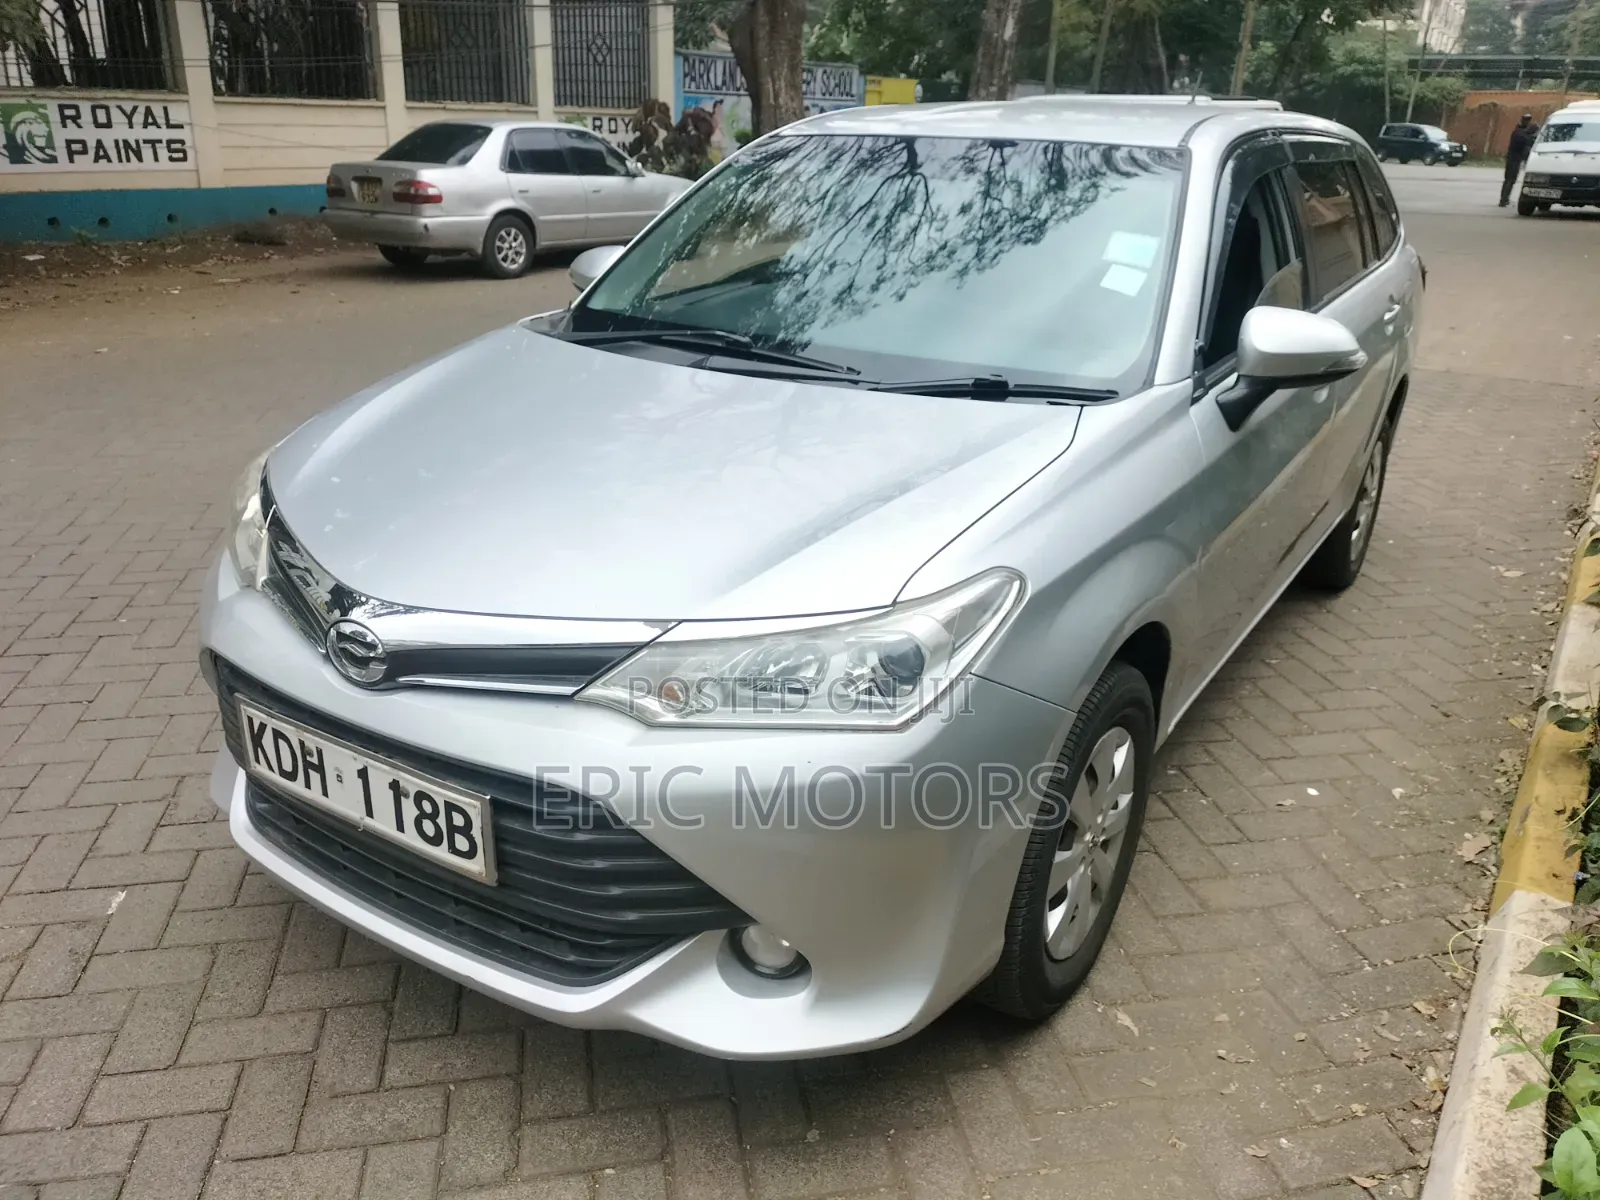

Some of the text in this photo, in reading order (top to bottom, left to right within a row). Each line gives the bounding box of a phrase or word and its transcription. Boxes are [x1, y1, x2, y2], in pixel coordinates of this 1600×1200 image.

[820, 68, 856, 98] SCHOOL
[57, 103, 184, 129] ROYAL
[592, 117, 634, 134] ROY
[65, 138, 188, 163] PAINTS
[247, 715, 478, 860] KDH 118B
